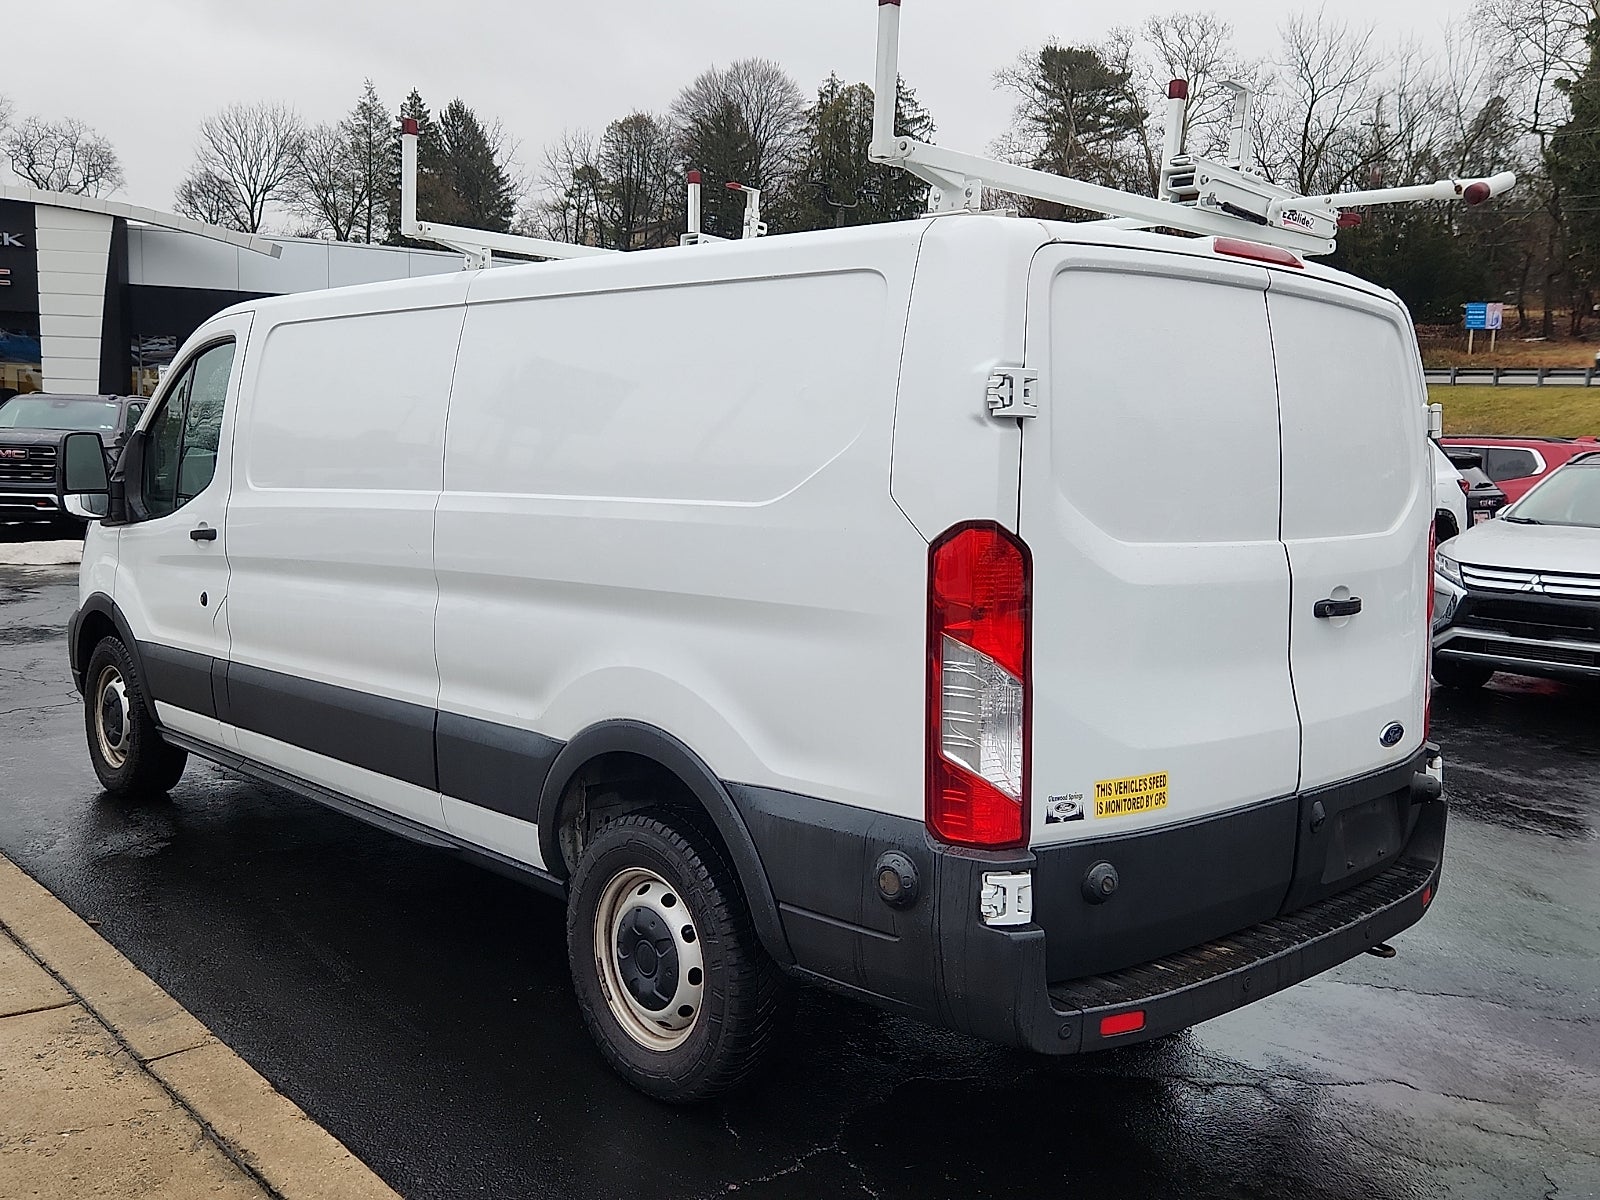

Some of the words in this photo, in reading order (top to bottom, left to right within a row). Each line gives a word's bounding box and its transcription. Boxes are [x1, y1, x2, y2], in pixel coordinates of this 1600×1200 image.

[1096, 782, 1113, 798] THIS
[1114, 778, 1148, 795] VEHICLE'S
[1148, 774, 1167, 790] SPEED
[1096, 801, 1104, 815] IS
[1105, 797, 1145, 814] MONITORED
[1145, 794, 1154, 807] BY
[1155, 791, 1166, 806] GPS
